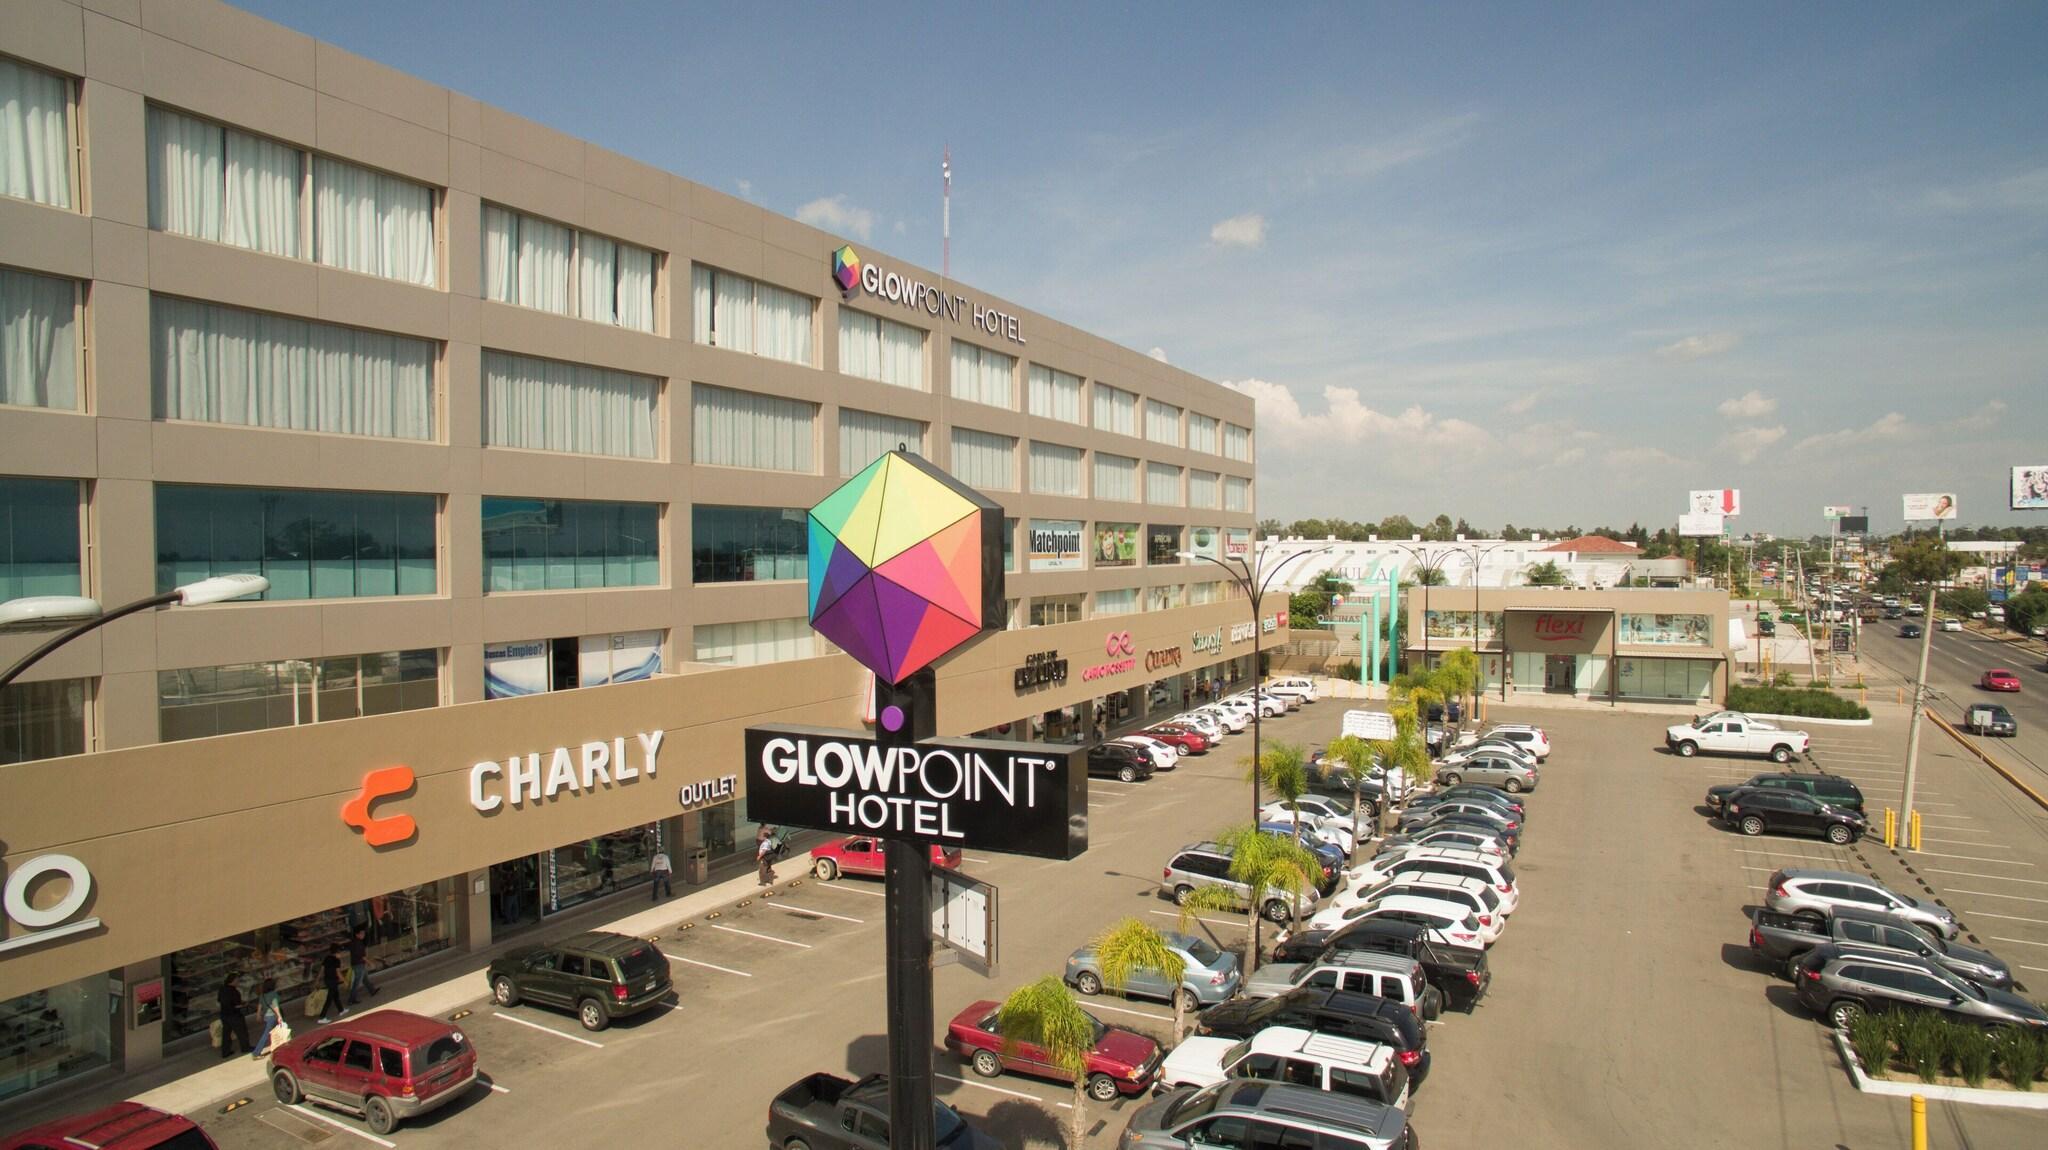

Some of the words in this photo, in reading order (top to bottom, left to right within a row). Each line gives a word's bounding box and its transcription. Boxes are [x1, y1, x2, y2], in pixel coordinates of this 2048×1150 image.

[973, 303, 1026, 343] HOTEL
[1535, 613, 1585, 634] flexi
[507, 643, 543, 658] Empleo?
[470, 730, 664, 811] CHARLY
[681, 774, 737, 806] OUTLET
[831, 791, 965, 838] HOTEL
